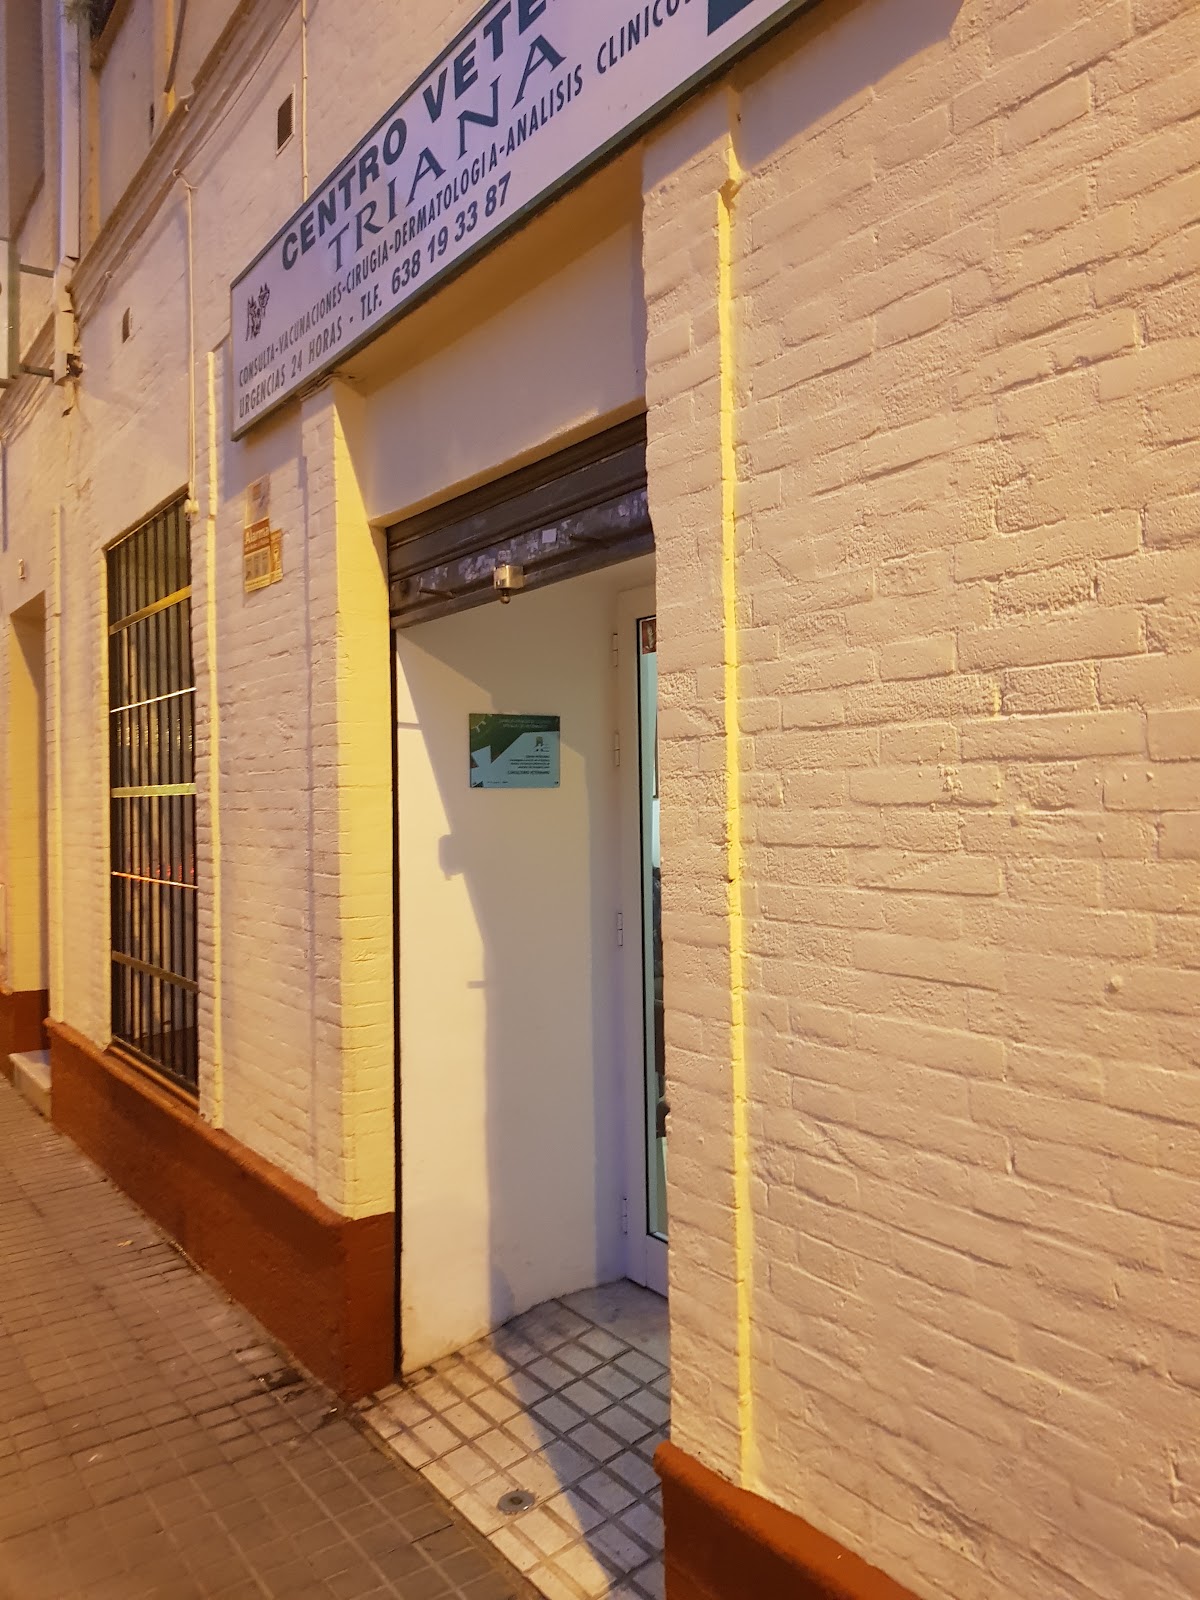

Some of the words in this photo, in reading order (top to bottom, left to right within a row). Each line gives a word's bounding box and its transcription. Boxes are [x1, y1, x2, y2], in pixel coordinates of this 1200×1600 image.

[597, 0, 690, 74] CLINICO
[283, 118, 407, 270] CENTRO
[328, 34, 567, 272] TRIANA
[239, 363, 285, 418] URGENCIAS
[291, 349, 302, 379] 24
[308, 315, 343, 364] HORAS
[360, 284, 382, 321] TLF.
[391, 249, 421, 295] 638
[427, 226, 449, 263] 19
[454, 200, 478, 242] 33
[484, 170, 511, 217] 87
